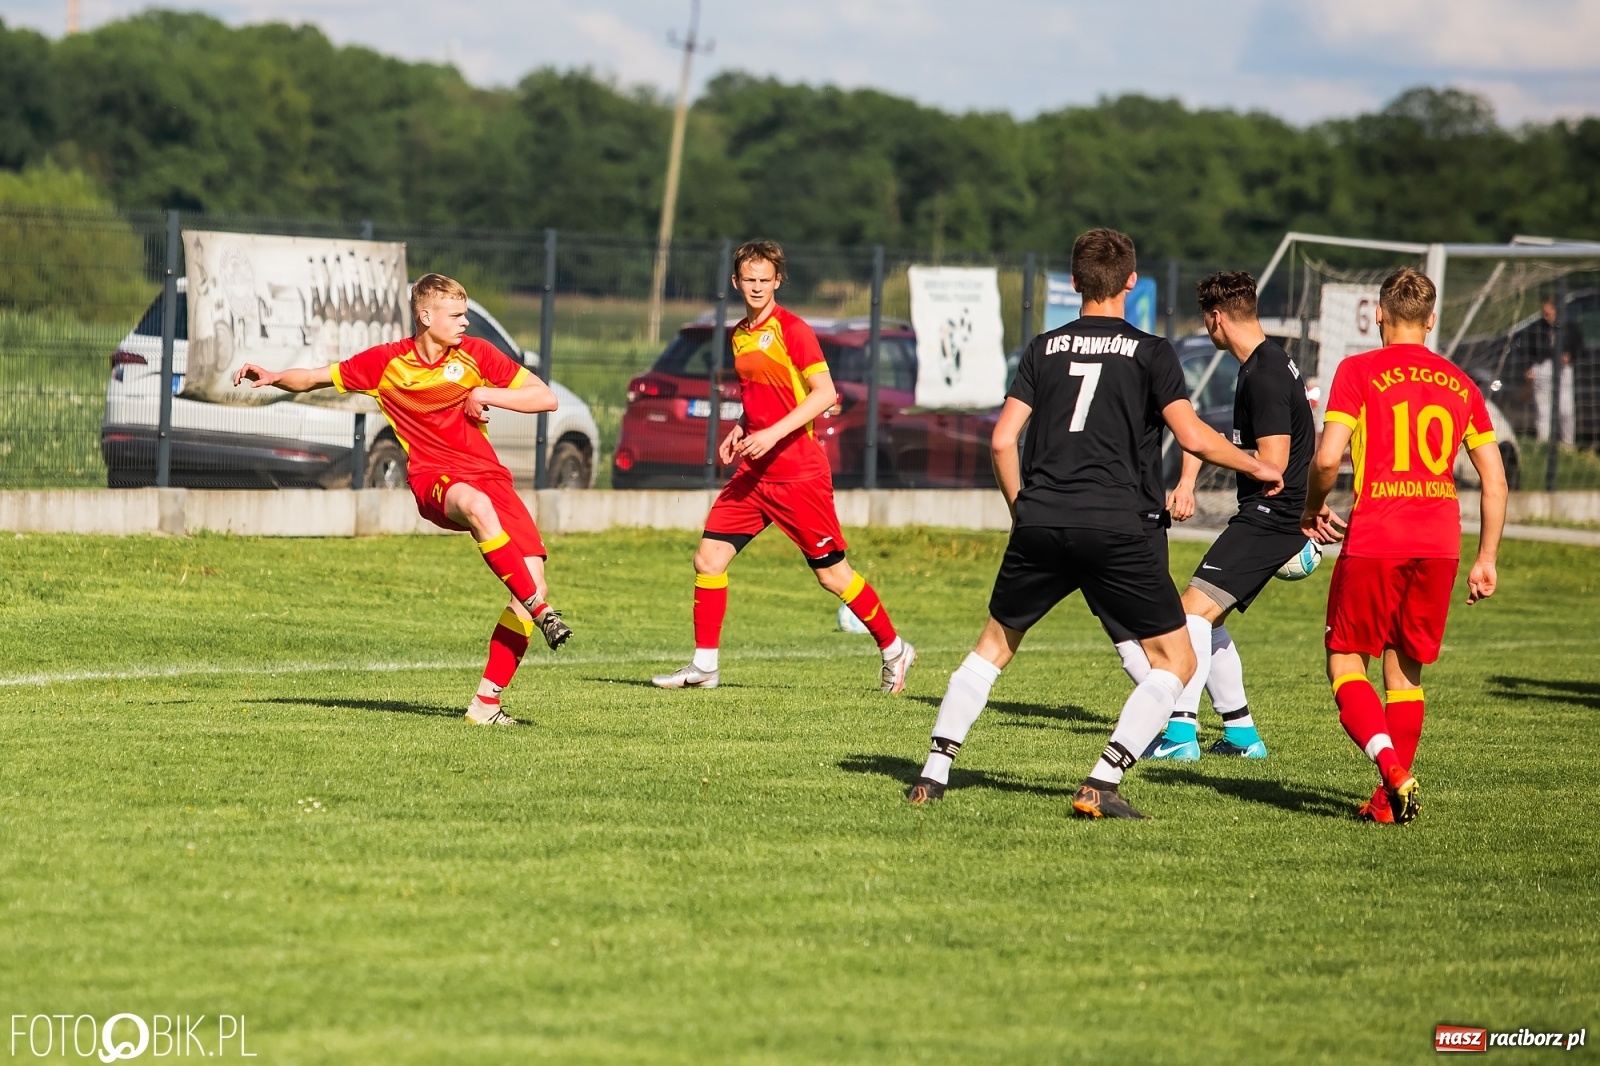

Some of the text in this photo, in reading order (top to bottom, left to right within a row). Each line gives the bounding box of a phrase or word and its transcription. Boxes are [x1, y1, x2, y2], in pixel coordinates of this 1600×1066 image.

[1045, 333, 1140, 358] LKS PAWŁÓW
[1068, 361, 1103, 433] 7
[1371, 366, 1470, 404] LKS ZGODA
[1391, 400, 1455, 476] 10
[1371, 480, 1424, 499] ZAWADA
